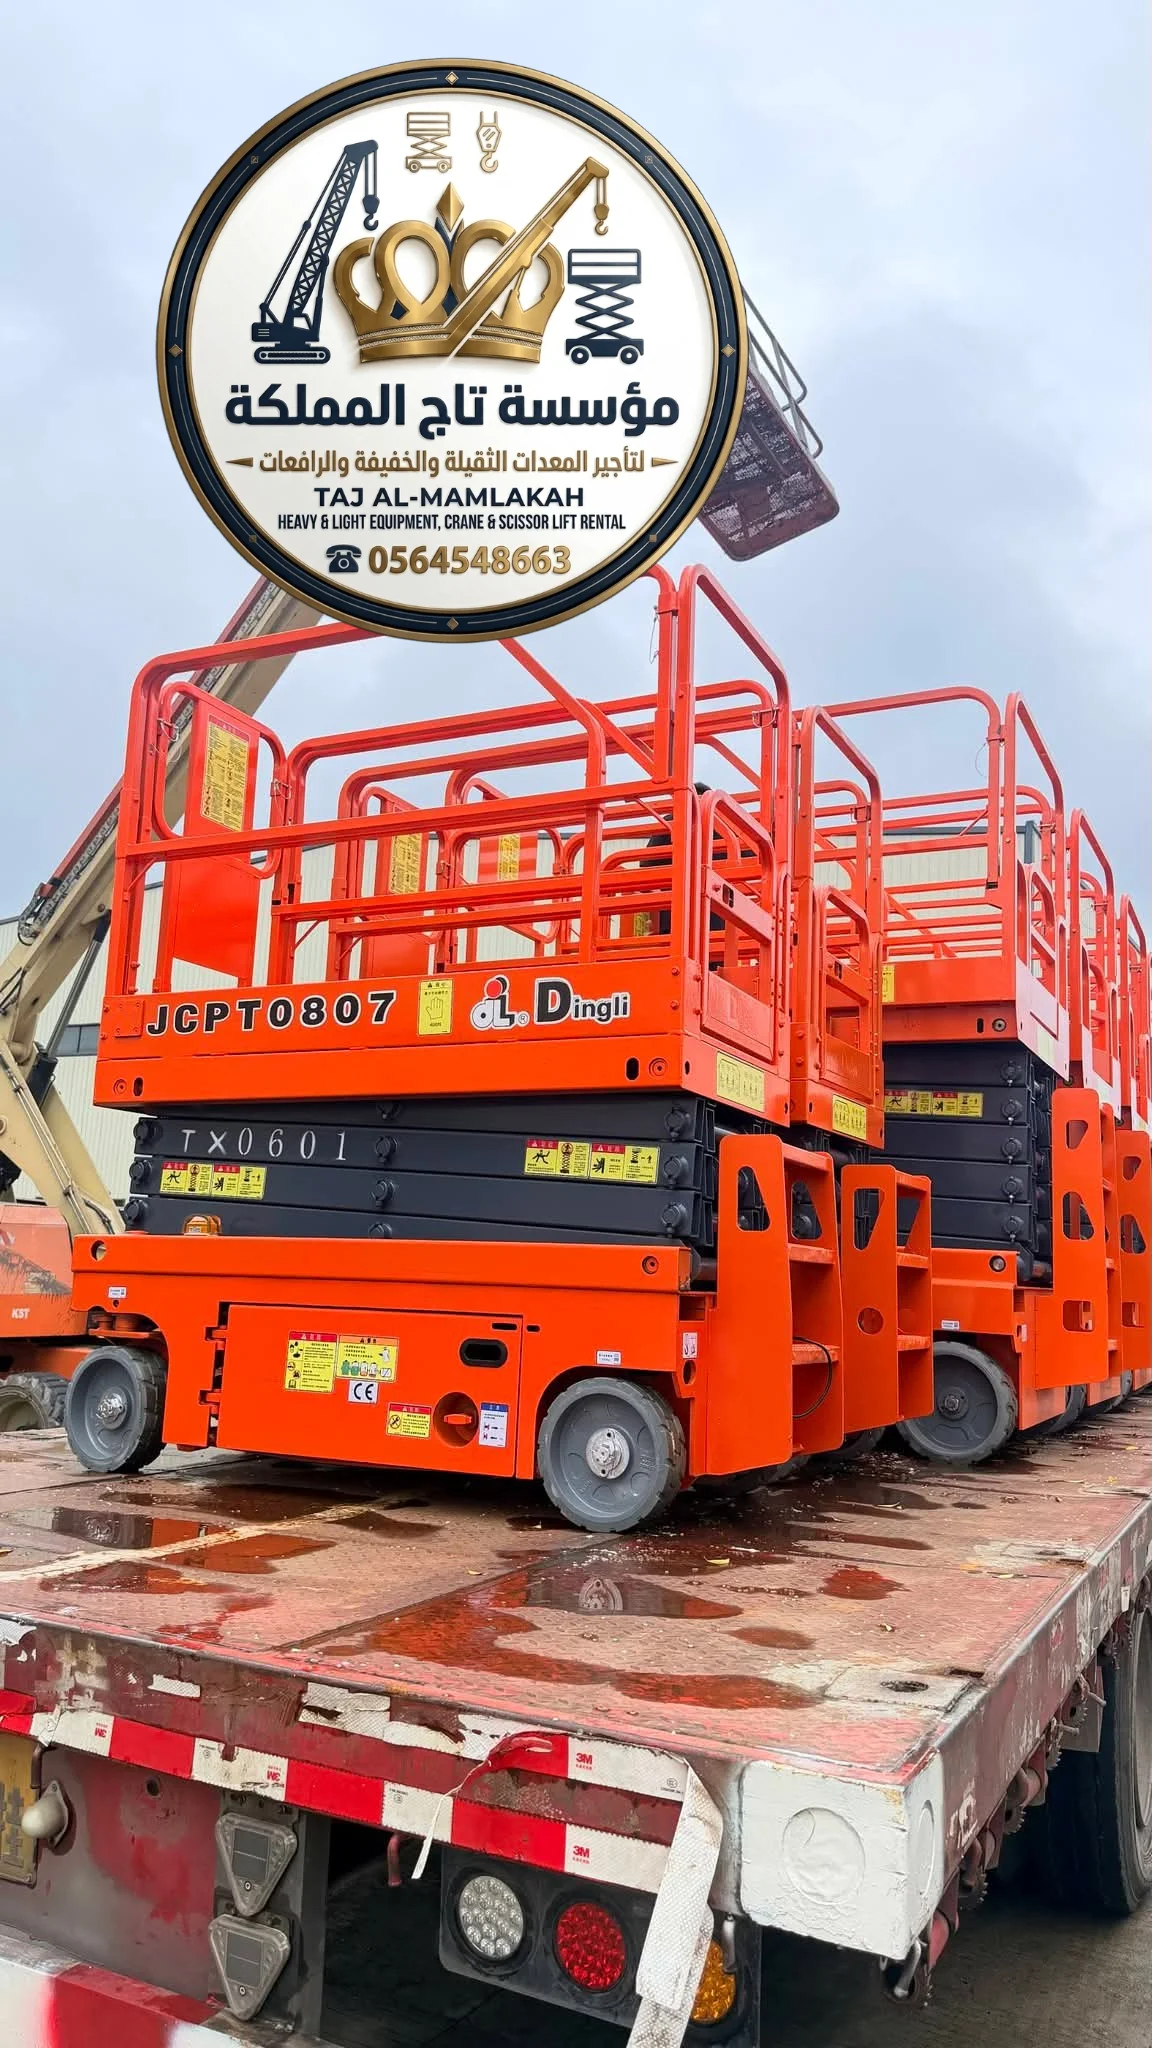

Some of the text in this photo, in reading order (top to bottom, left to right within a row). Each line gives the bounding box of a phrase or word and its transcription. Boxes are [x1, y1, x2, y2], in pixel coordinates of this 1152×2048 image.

[147, 990, 397, 1036] JCPT0807
[535, 977, 630, 1024] Dingli
[181, 1127, 347, 1161] TX0601
[353, 1382, 375, 1401] CE
[575, 1752, 593, 1765] 3M
[573, 1845, 590, 1858] 3M
